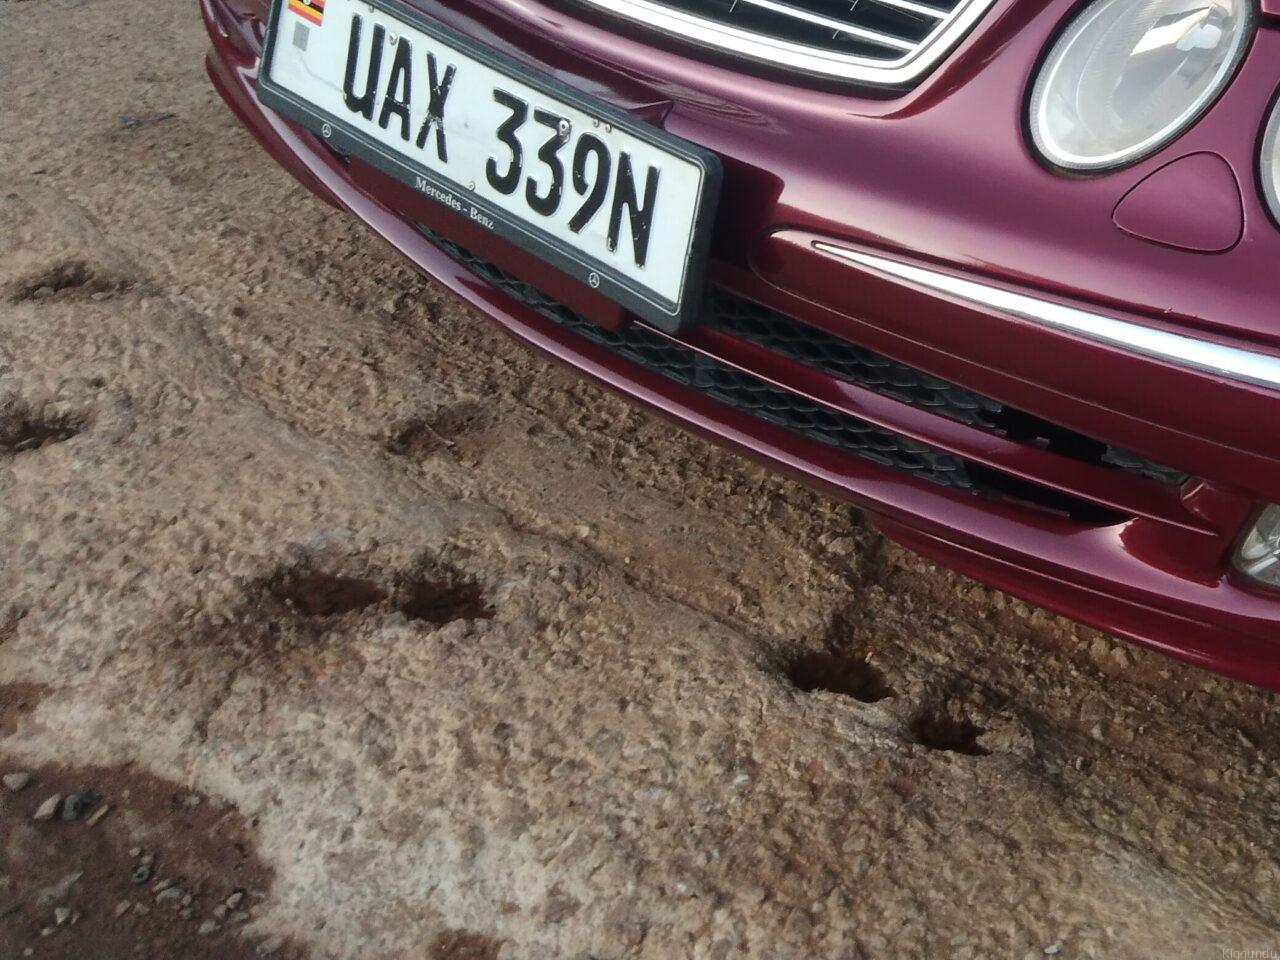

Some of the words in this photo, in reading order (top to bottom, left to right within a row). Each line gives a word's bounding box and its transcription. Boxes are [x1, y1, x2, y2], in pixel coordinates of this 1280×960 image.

[343, 13, 457, 164] UAX
[485, 88, 662, 269] 339N
[415, 176, 462, 211] Mercedes
[469, 207, 495, 230] Benz
